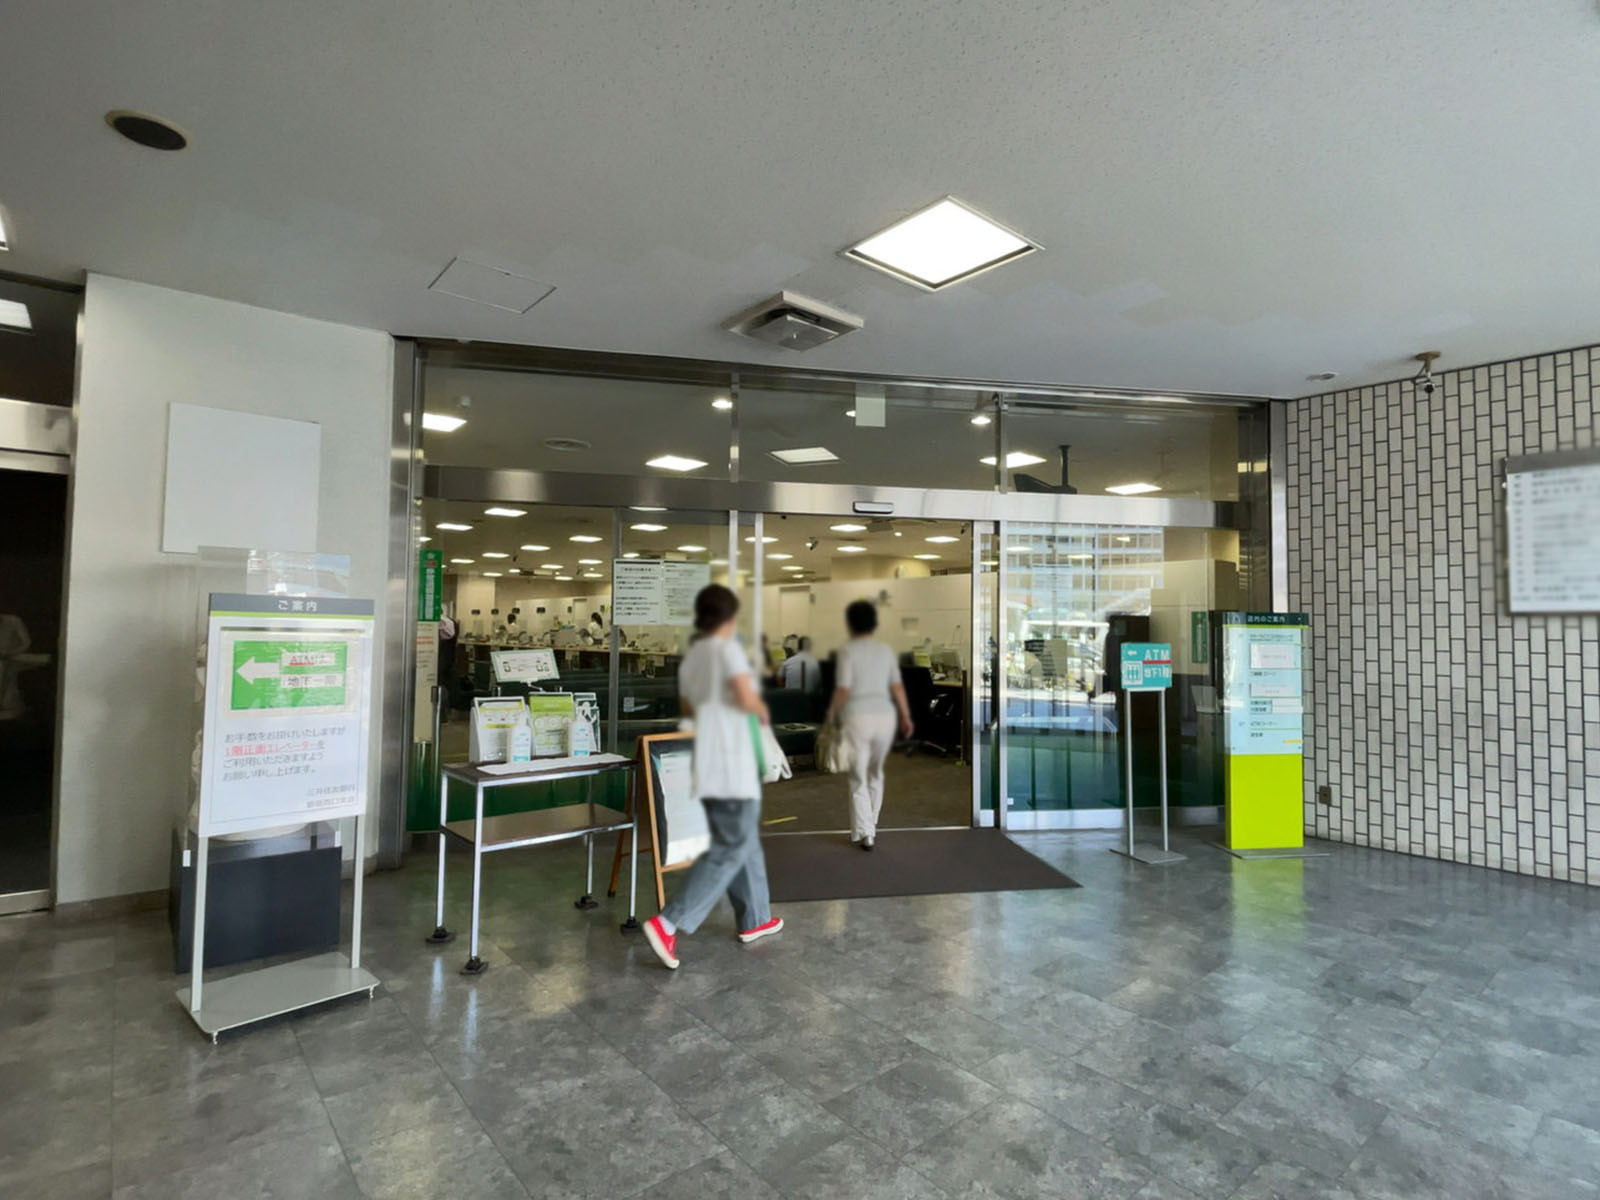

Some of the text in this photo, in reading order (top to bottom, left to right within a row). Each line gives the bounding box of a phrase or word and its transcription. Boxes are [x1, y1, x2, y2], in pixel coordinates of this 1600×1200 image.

[277, 600, 317, 612] ご案内
[1144, 649, 1170, 661] ATM
